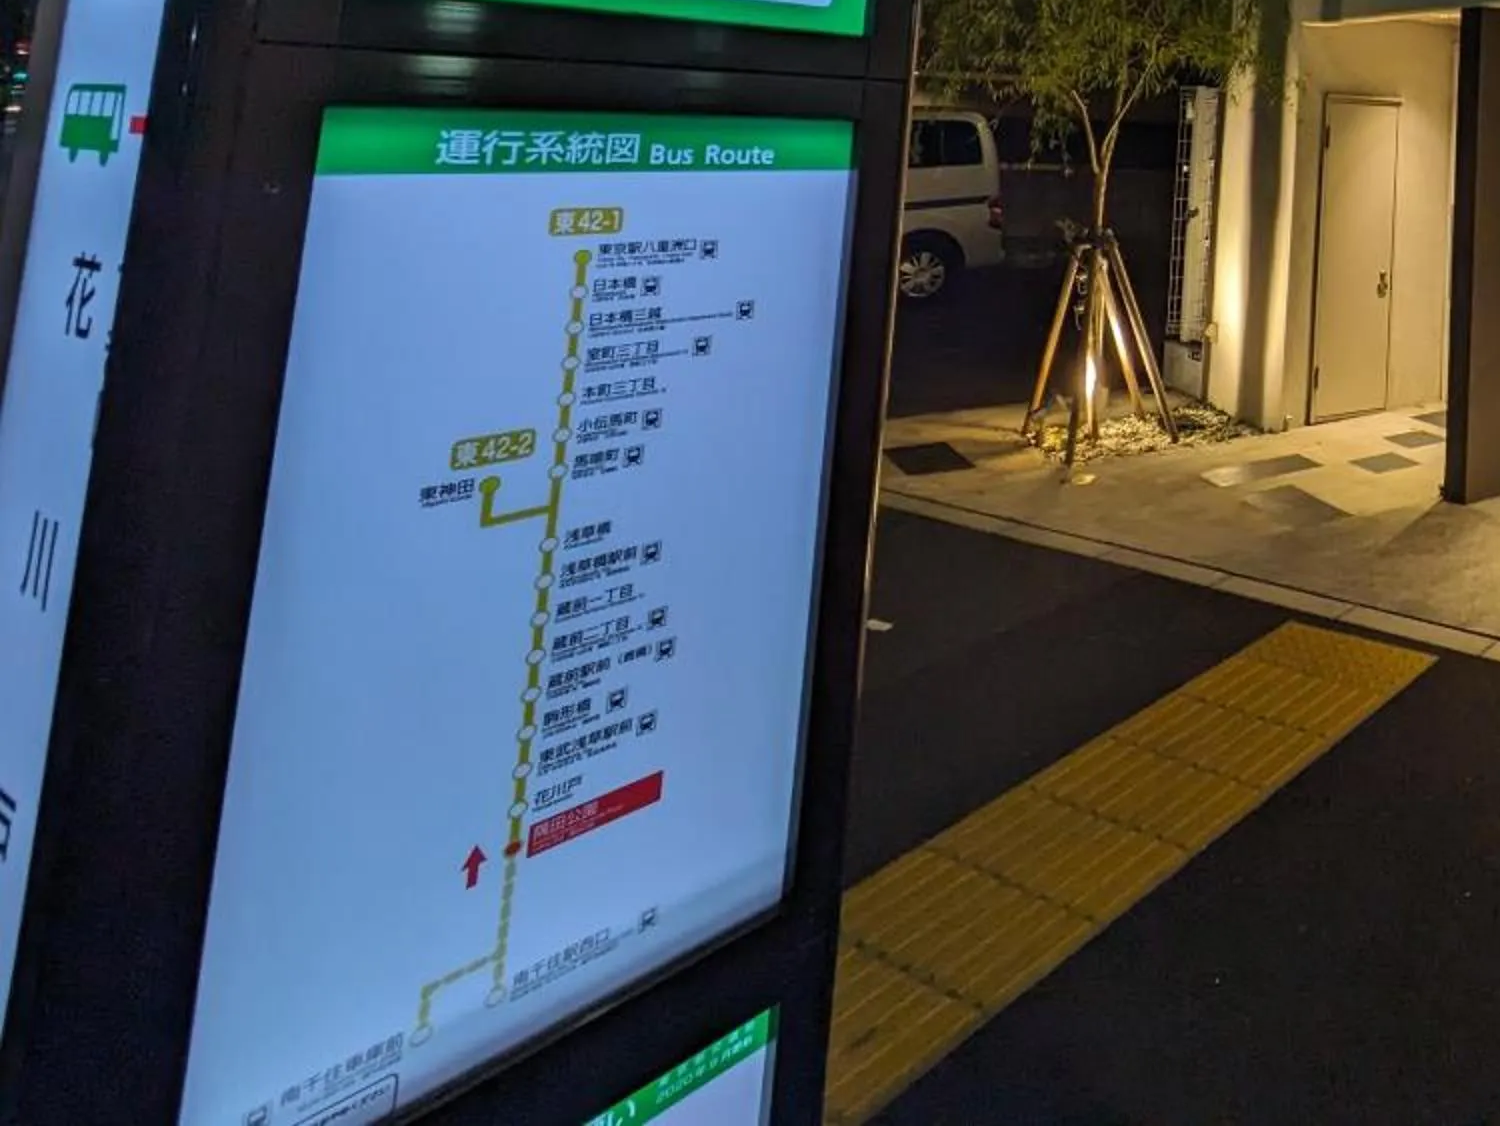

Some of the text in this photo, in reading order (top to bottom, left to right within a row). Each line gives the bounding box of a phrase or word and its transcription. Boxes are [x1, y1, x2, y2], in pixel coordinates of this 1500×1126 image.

[435, 129, 641, 165] 運行系統図
[650, 144, 775, 165] Bus Route
